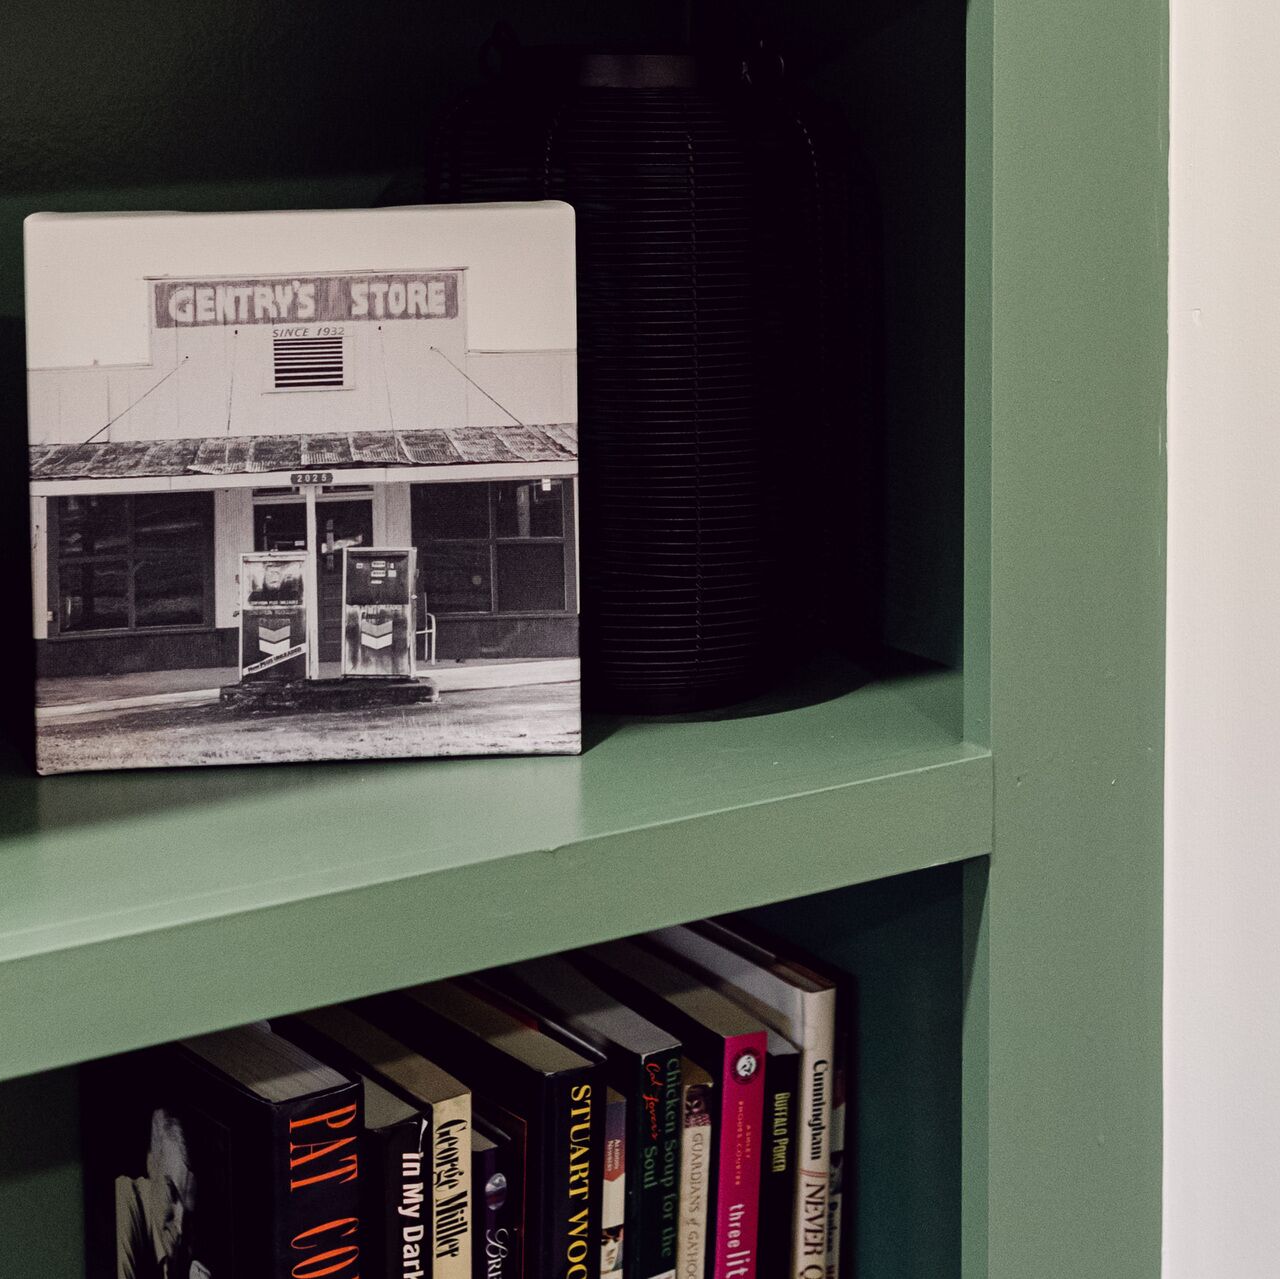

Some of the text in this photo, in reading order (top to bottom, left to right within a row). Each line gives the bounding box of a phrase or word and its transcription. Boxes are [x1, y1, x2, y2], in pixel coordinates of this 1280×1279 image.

[169, 281, 446, 322] GENTRY'S STORE
[272, 326, 346, 338] SINCE 1932
[297, 474, 327, 483] 2025
[289, 1103, 359, 1193] PAT
[433, 1118, 469, 1190] George
[566, 1083, 593, 1200] STUART
[643, 1145, 659, 1189] Soul
[660, 1058, 682, 1257] Chicken Soup for the
[772, 1092, 791, 1173] BUFFALO POKER
[803, 1059, 828, 1257] Cunningham NEVER
[397, 1150, 425, 1219] In My
[687, 1132, 704, 1213] GUARDIANS
[726, 1203, 745, 1249] three
